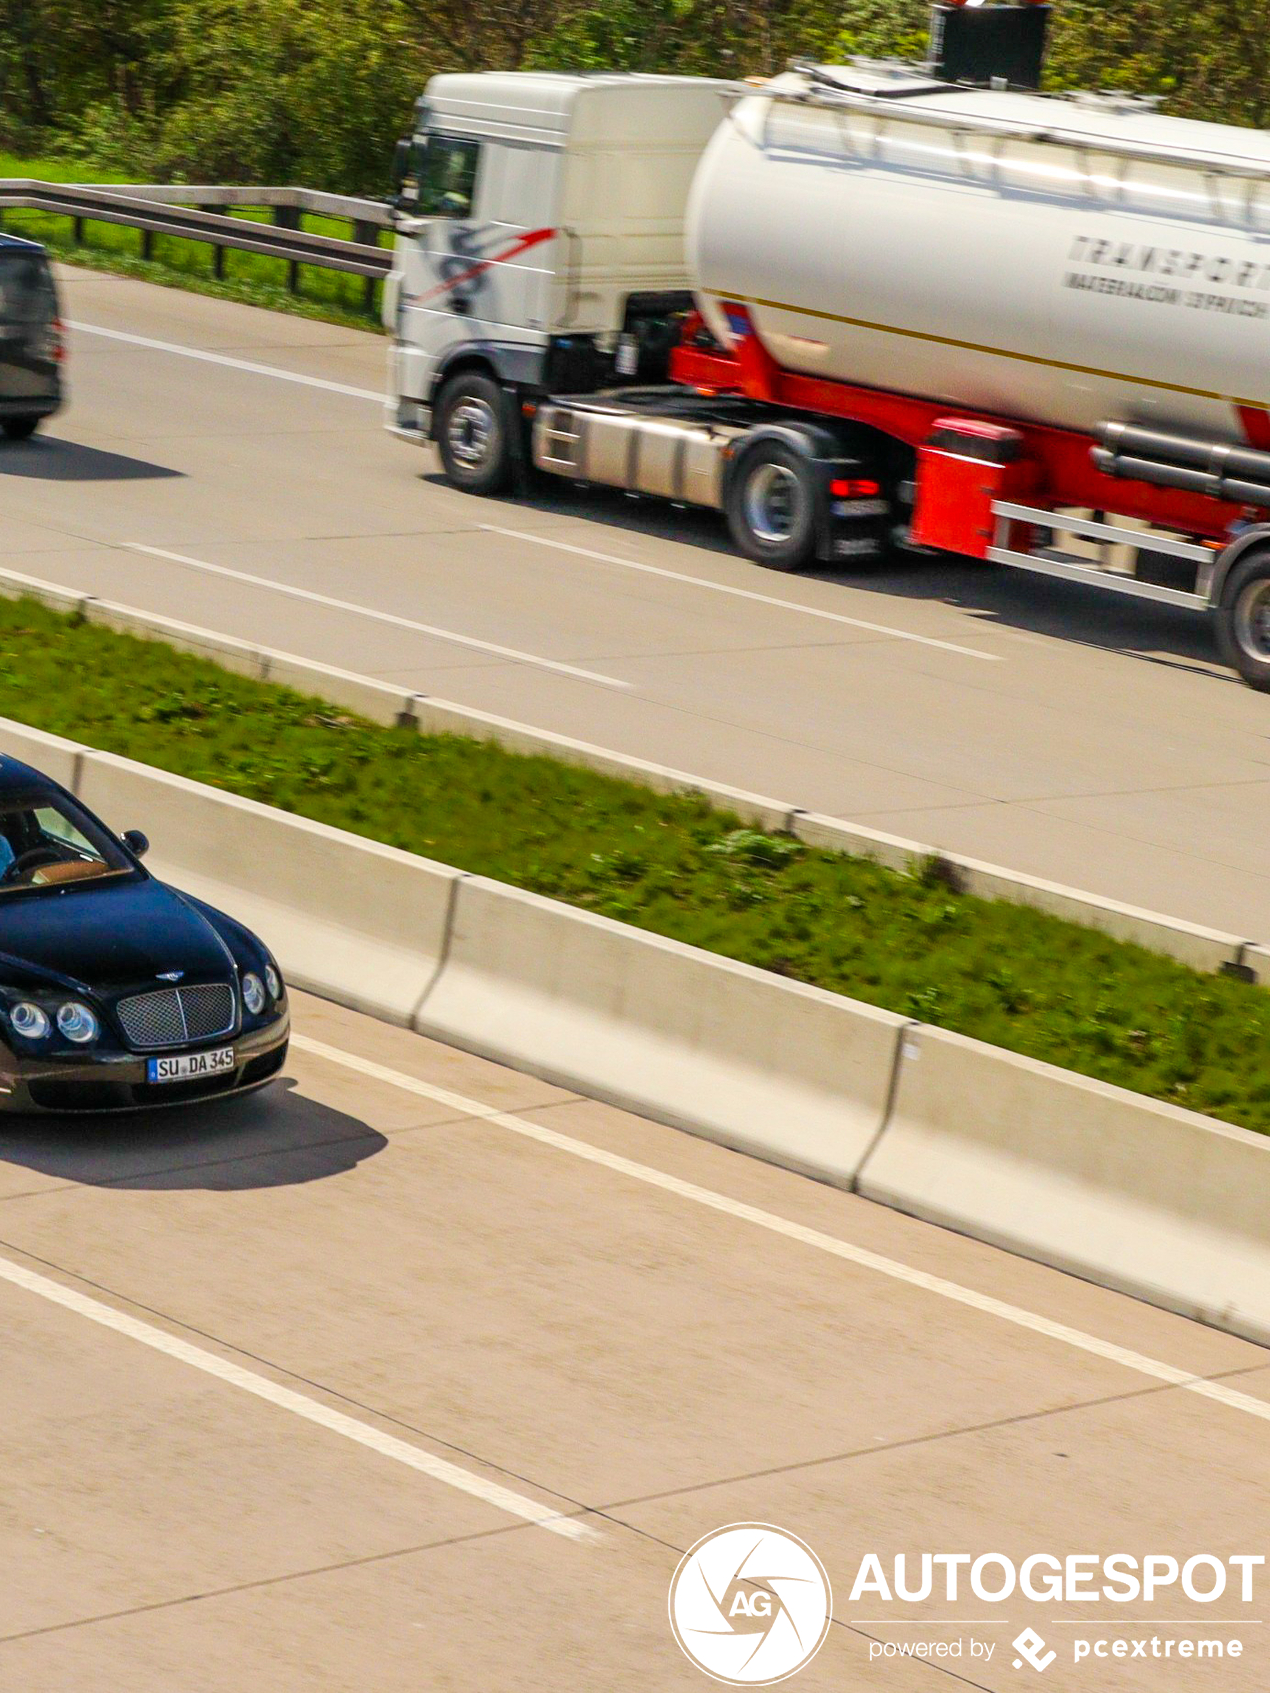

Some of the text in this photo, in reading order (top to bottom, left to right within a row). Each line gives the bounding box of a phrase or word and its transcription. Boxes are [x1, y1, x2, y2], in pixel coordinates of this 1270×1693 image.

[159, 1059, 179, 1077] SU
[189, 1055, 207, 1073] DA
[210, 1050, 233, 1069] 345
